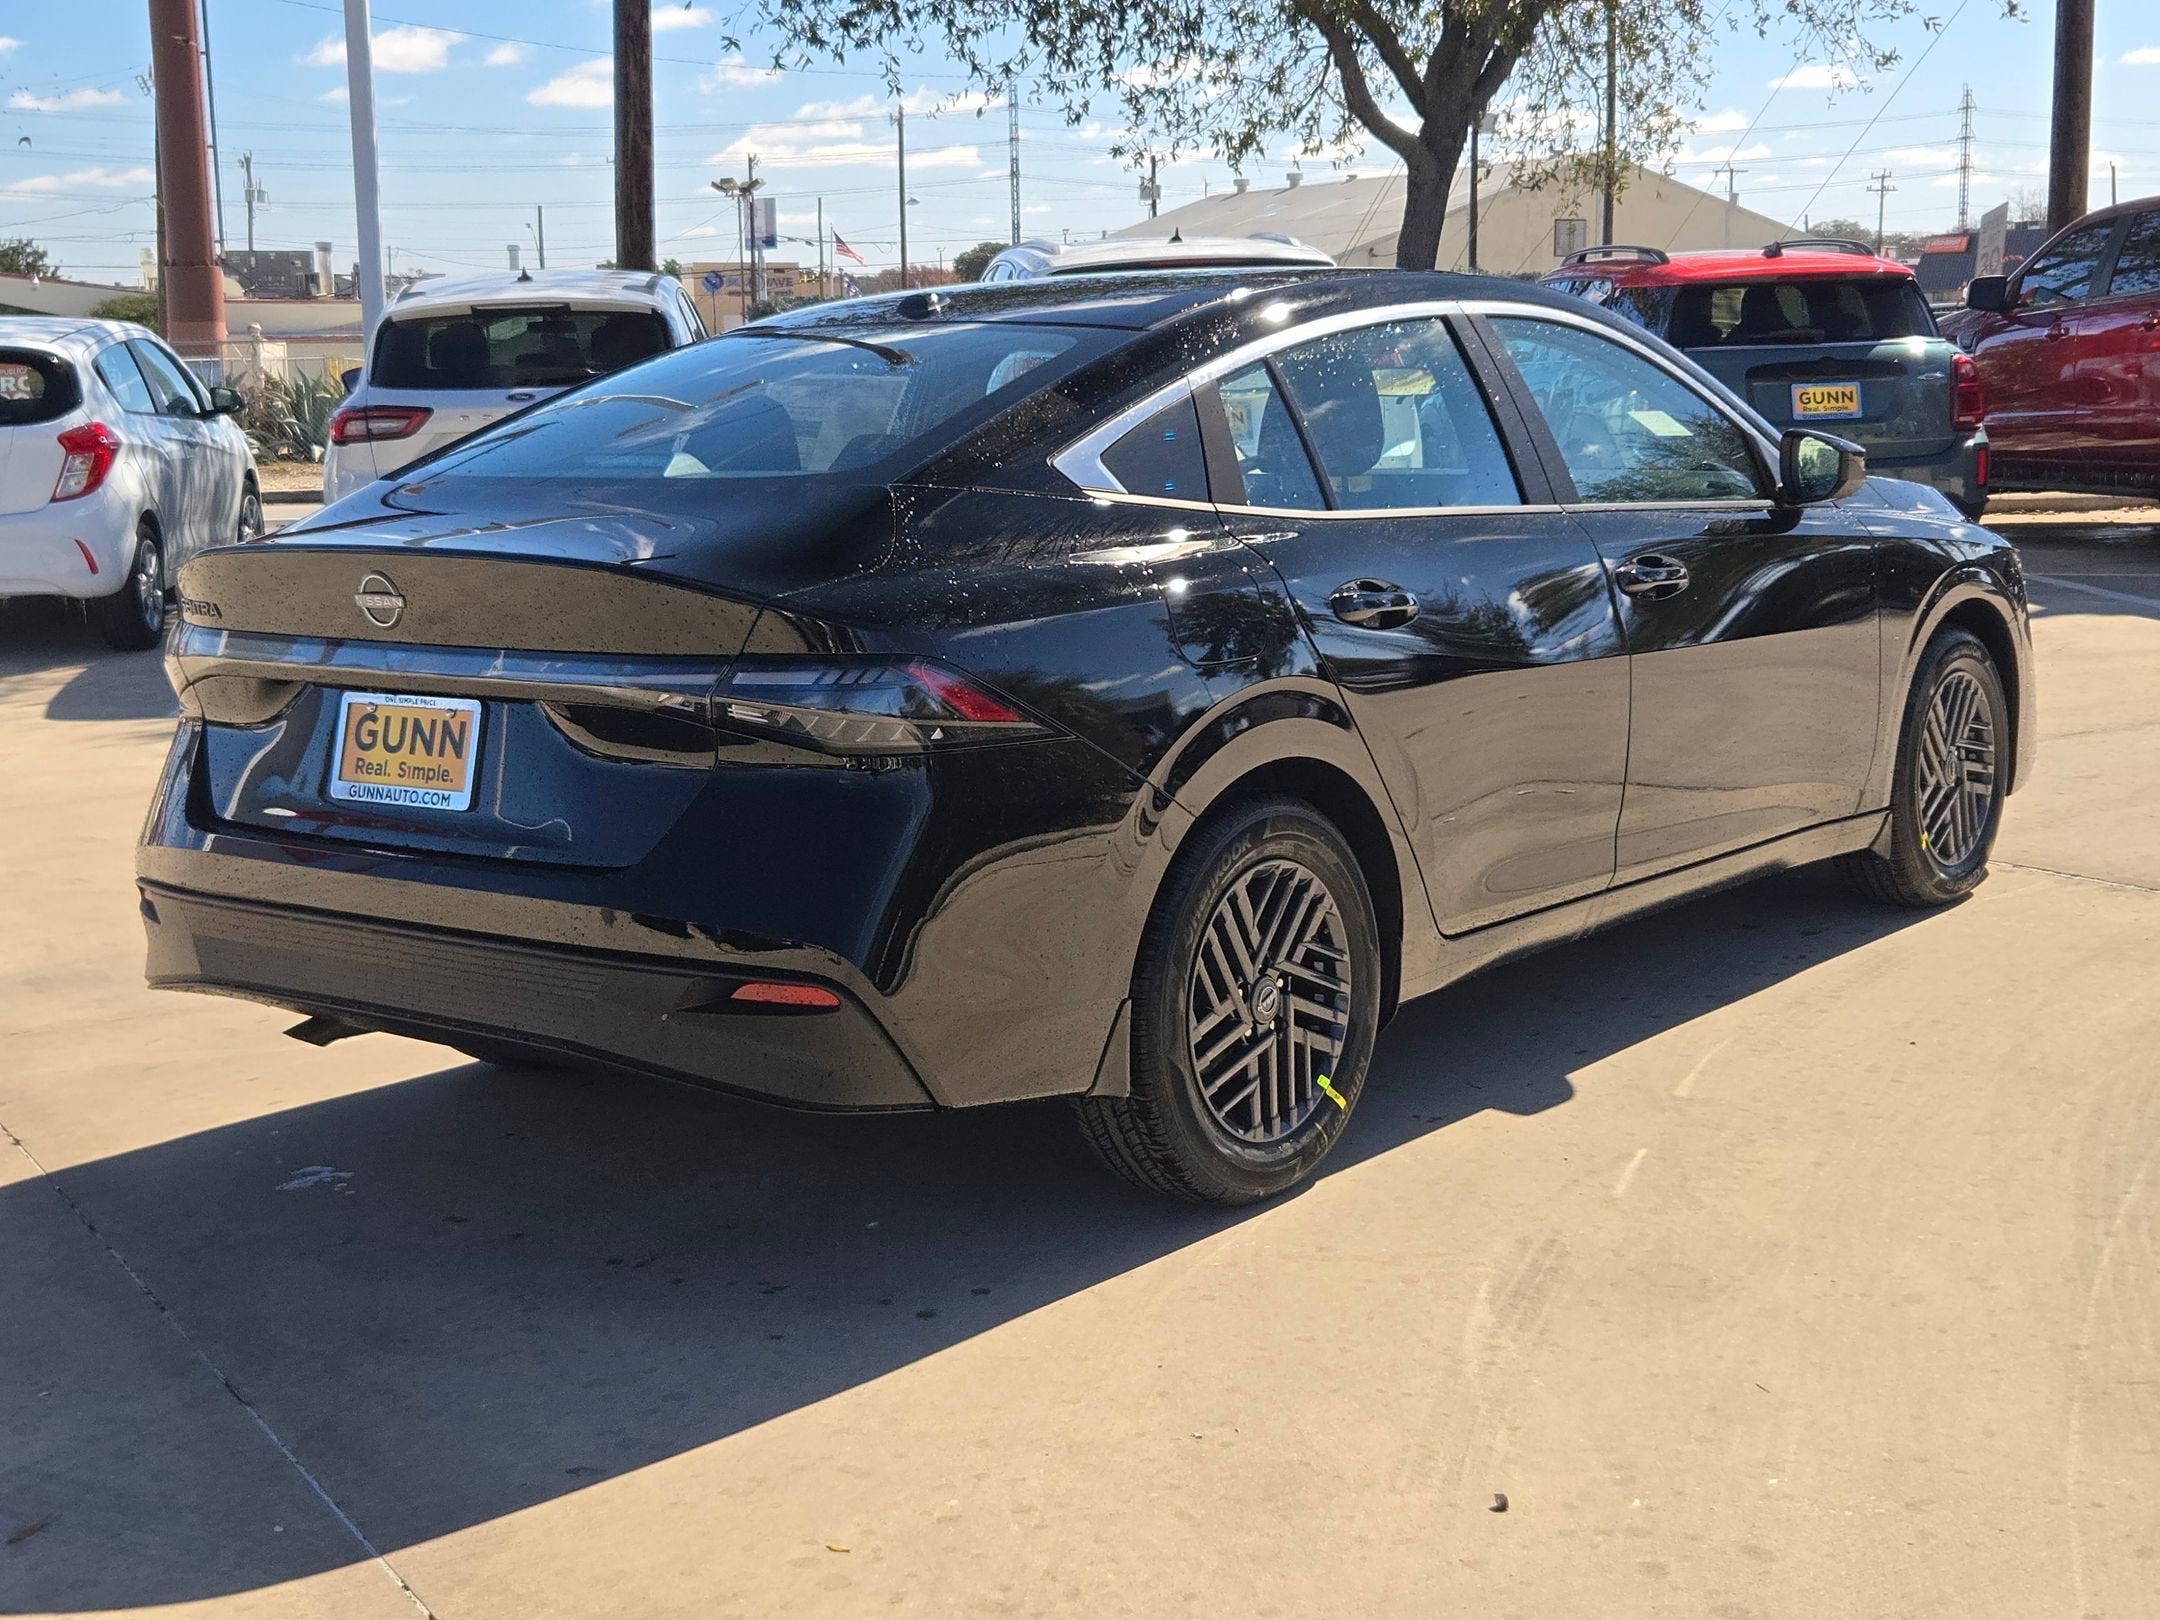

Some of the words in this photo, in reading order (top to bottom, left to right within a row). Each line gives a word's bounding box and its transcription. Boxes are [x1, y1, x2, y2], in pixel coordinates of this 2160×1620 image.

[1799, 391, 1854, 405] GUNN
[354, 594, 402, 607] NISSAN
[354, 713, 467, 759] GUNN
[354, 757, 391, 777] Real.
[349, 784, 451, 807] GUNNAUTO.COM
